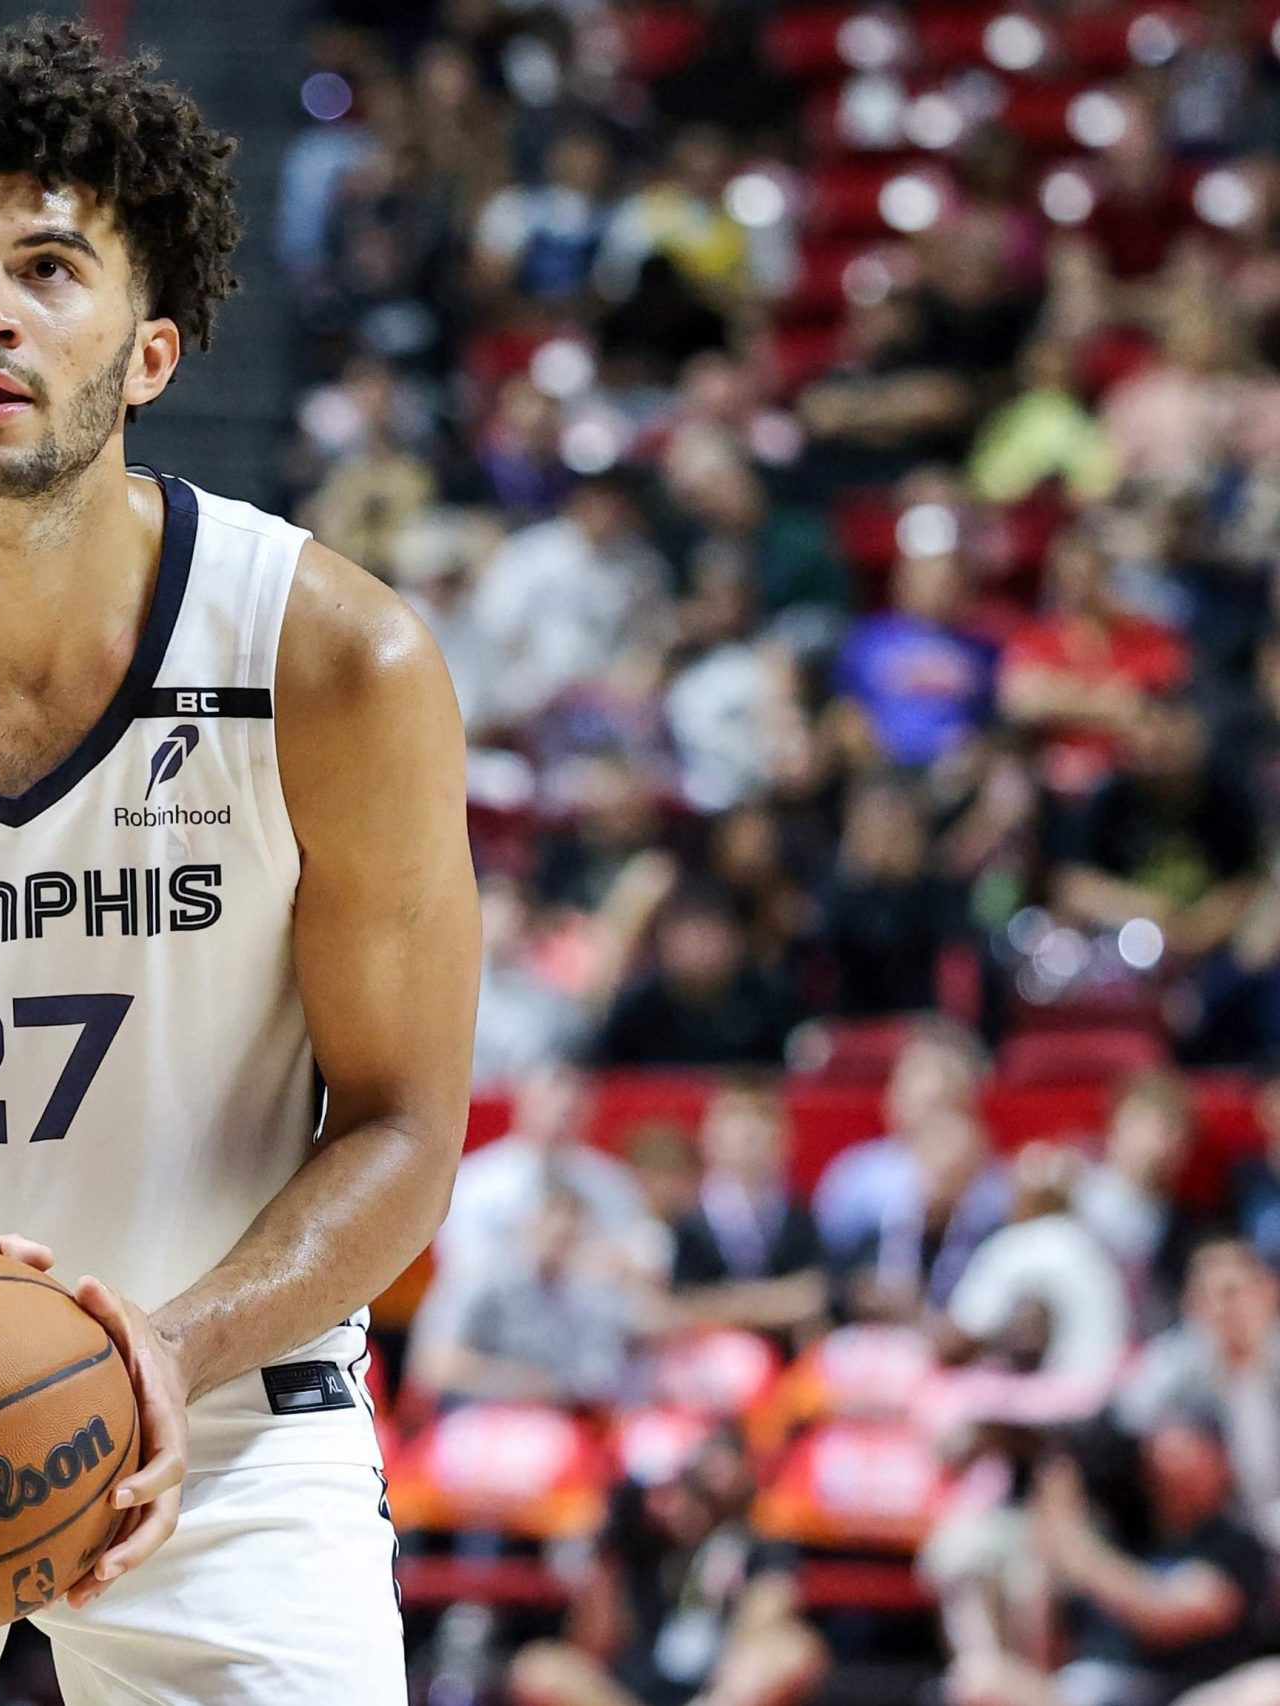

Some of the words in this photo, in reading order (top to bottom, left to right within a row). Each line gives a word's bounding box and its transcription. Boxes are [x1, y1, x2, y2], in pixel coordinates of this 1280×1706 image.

[176, 692, 220, 712] BC
[114, 804, 231, 827] Robinhood
[325, 1375, 343, 1394] XL
